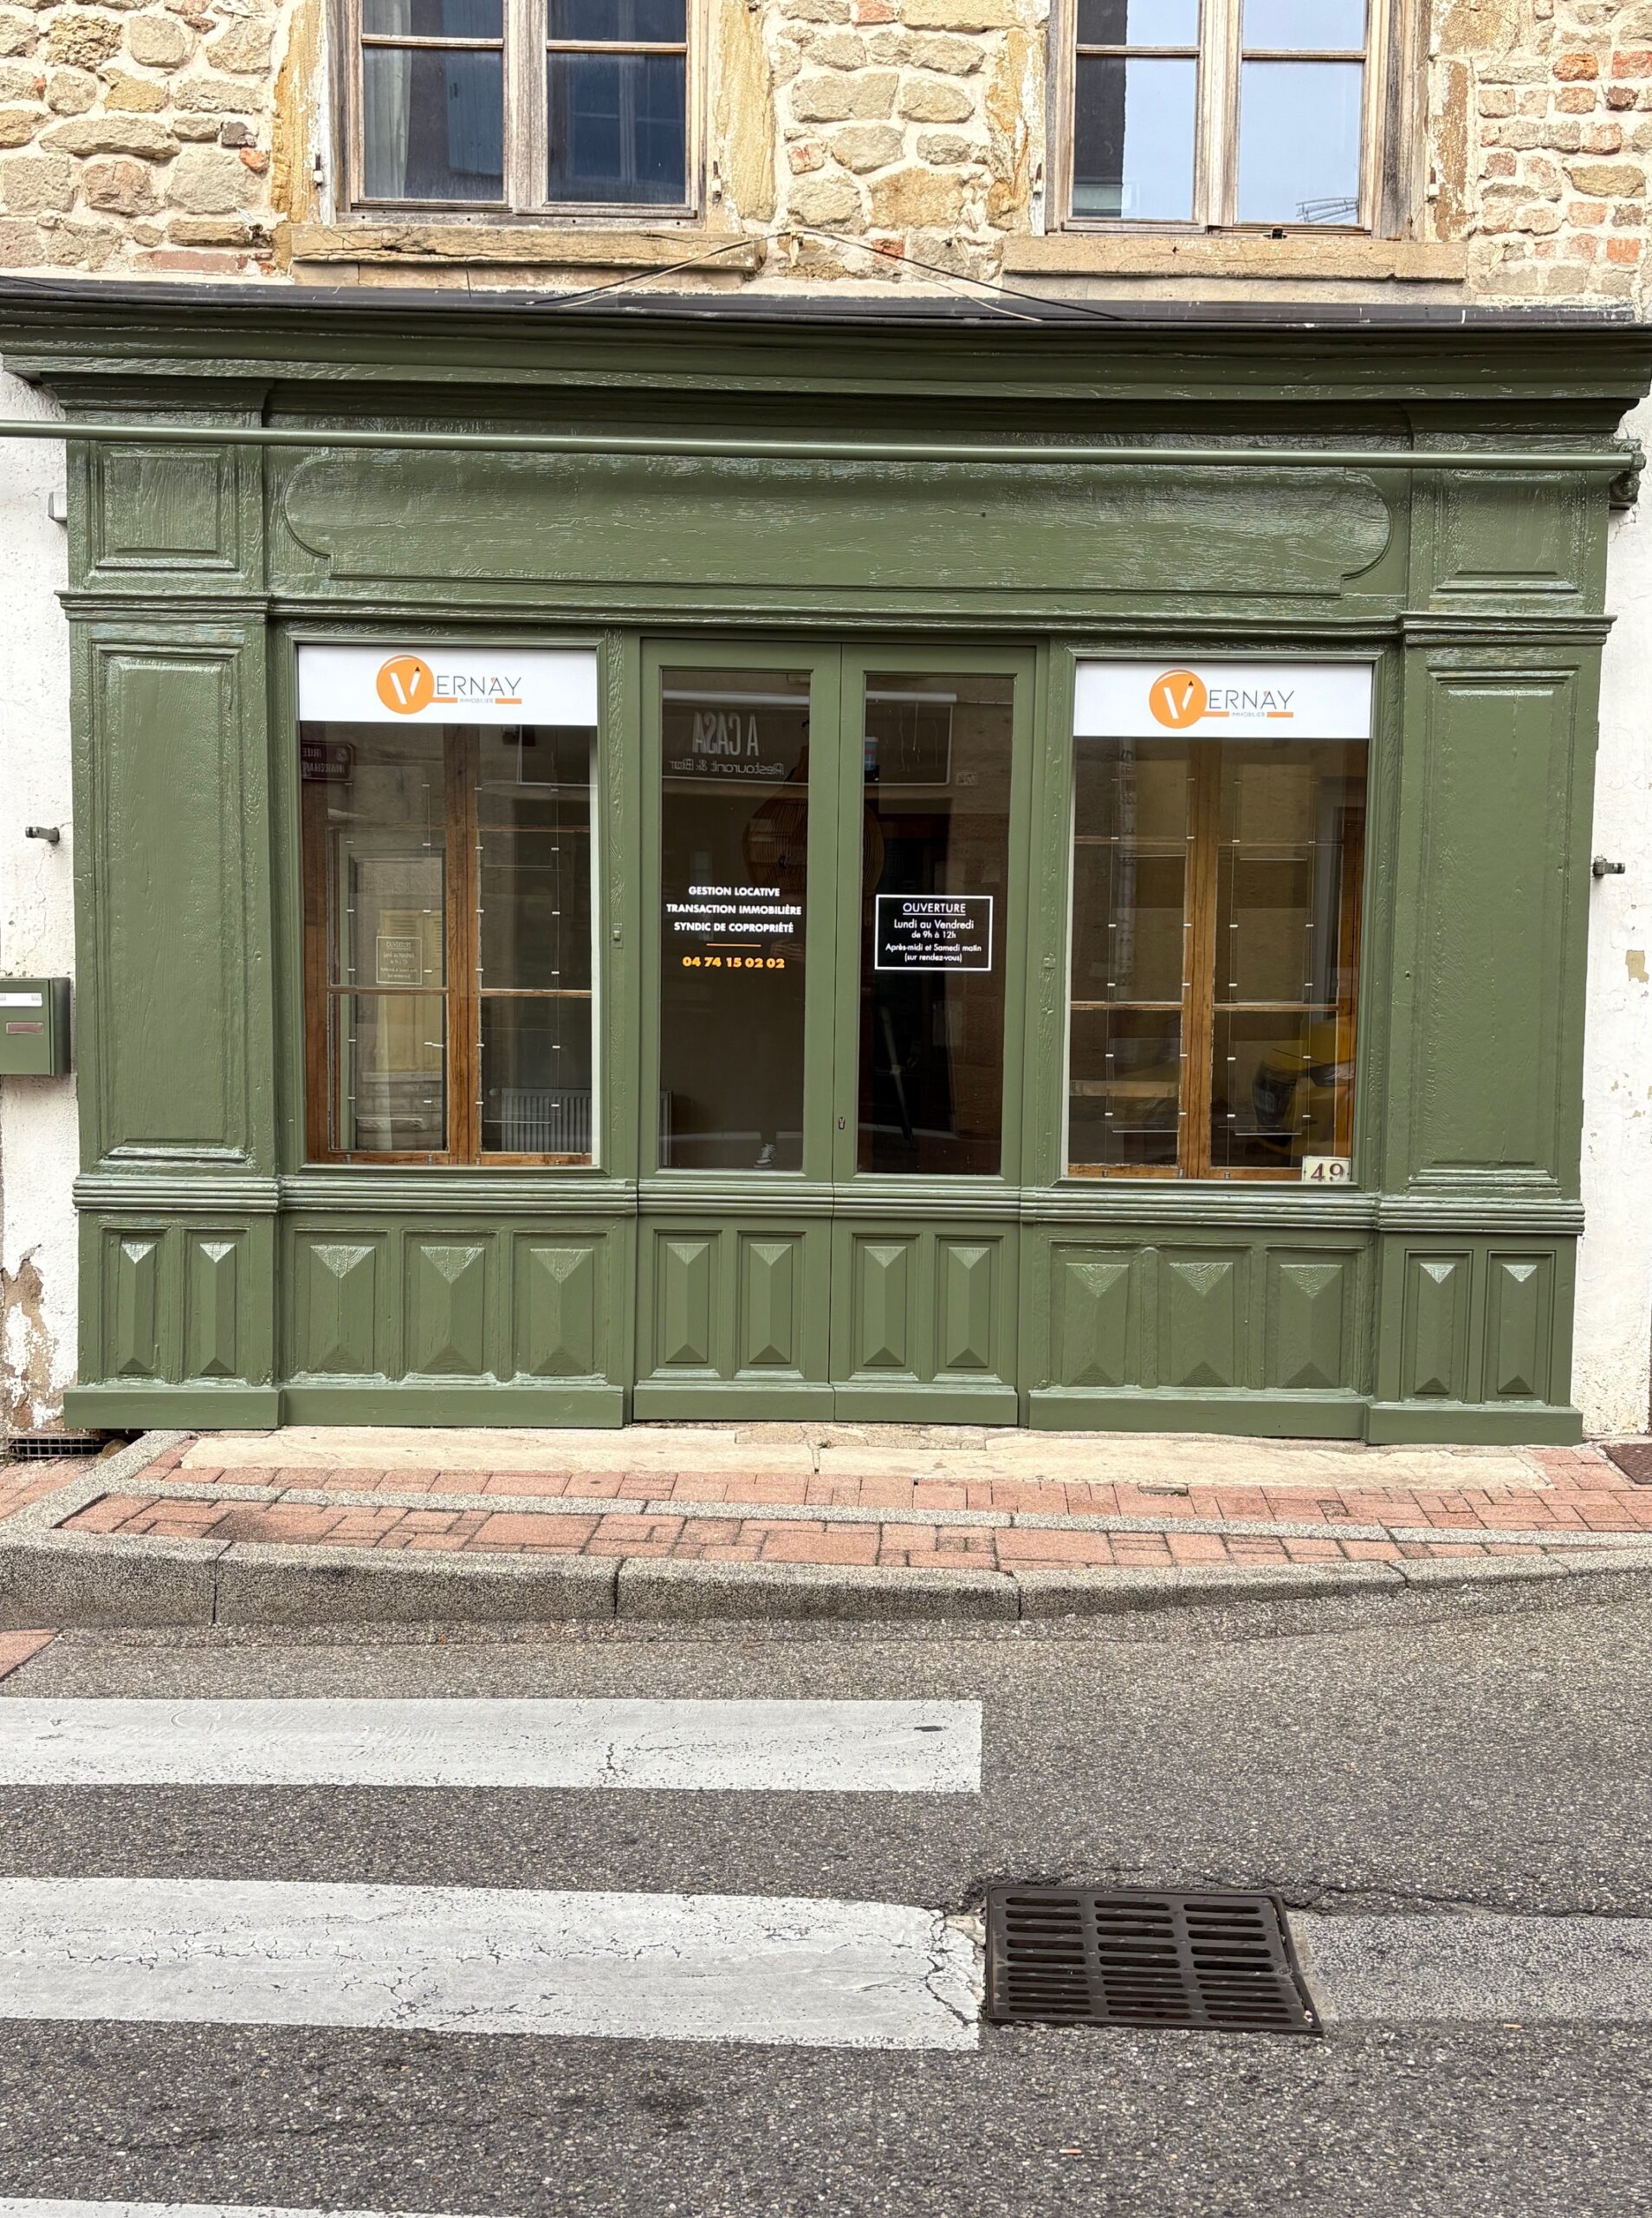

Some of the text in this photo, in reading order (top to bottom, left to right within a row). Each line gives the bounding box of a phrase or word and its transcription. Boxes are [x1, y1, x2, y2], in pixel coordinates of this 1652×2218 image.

[390, 666, 522, 706] VERNAY
[1163, 680, 1295, 719] VERNAY
[689, 886, 781, 897] GESTION LOCATIVE
[666, 904, 802, 915] TRANSACTION IMMOBILIÈRE
[903, 903, 966, 913] OUVERTURE
[674, 922, 794, 933] SYNDIC DE COPROPRIÉTÉ
[894, 918, 917, 929] Lundi
[934, 919, 974, 930] Vendredi
[885, 944, 923, 952] Après-midi
[683, 957, 785, 969] 04 74 15 02 02
[904, 953, 962, 963] (sur rendez-vous)
[1310, 1163, 1344, 1181] 49
